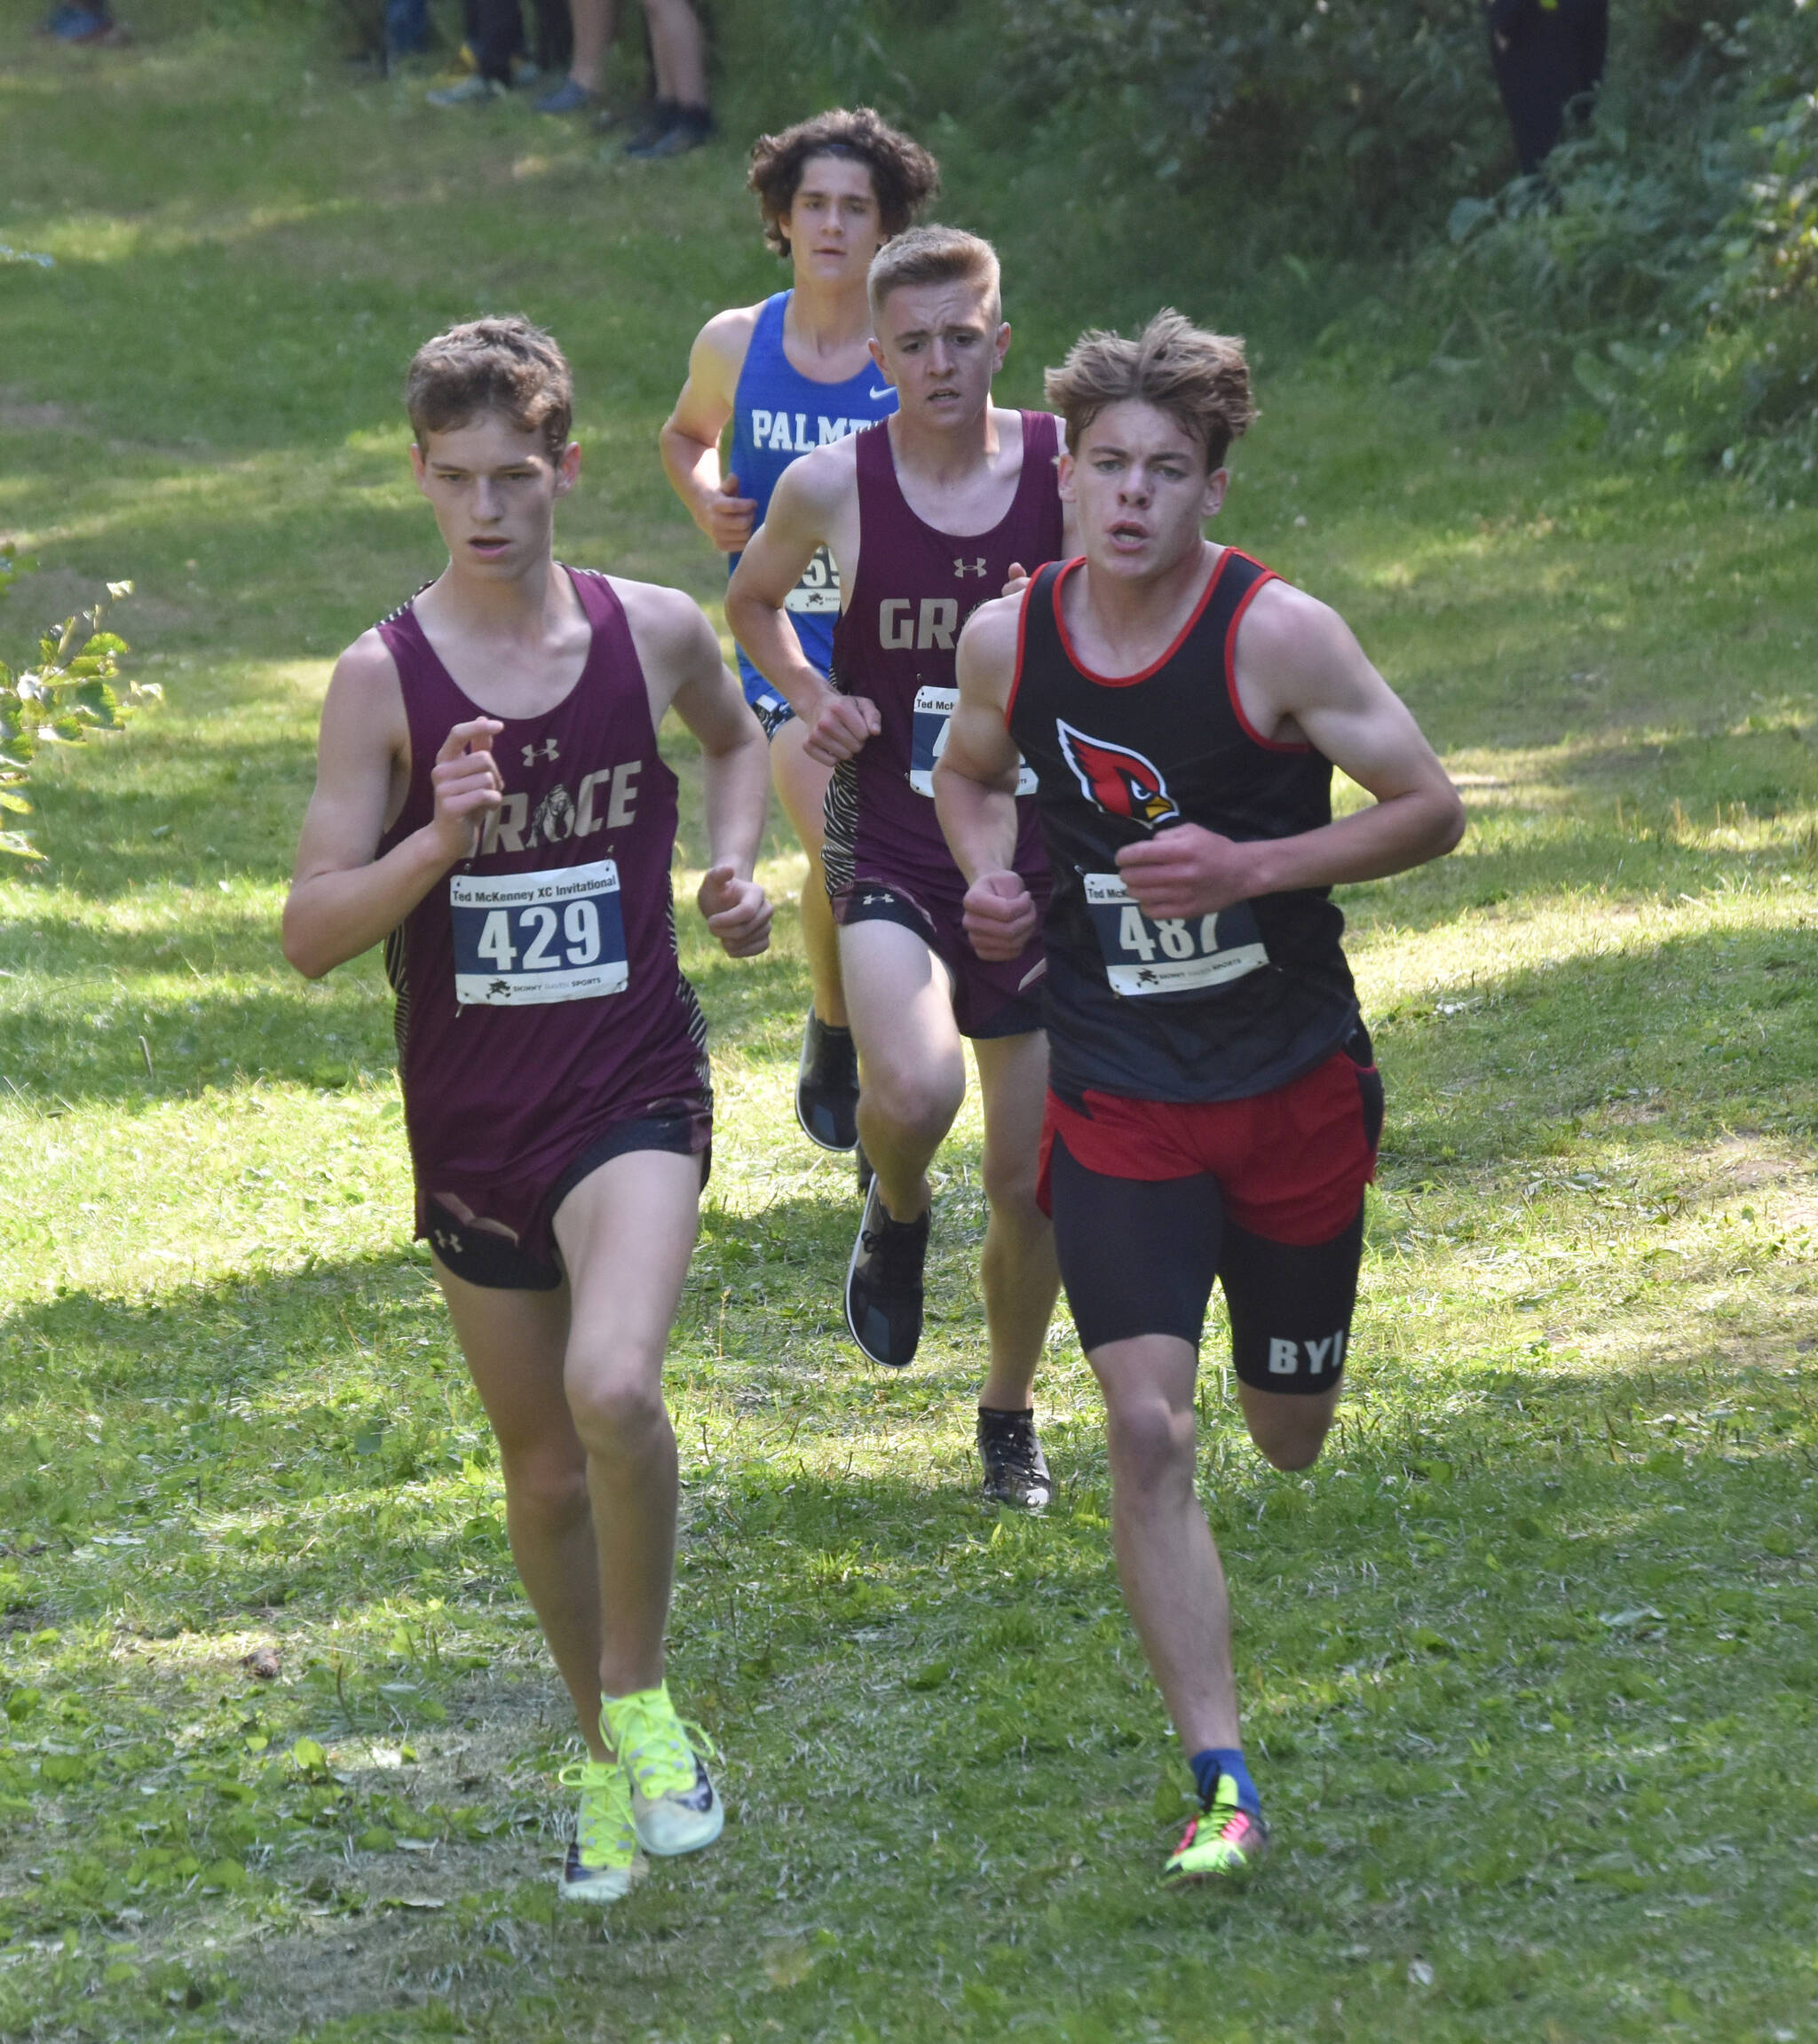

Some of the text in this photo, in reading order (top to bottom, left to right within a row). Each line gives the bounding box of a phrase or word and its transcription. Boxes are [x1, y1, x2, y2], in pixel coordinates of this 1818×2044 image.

[917, 699, 933, 709] Ted
[453, 875, 616, 902] Ted McKenney XC Invitational
[1087, 889, 1104, 899] Ted
[478, 899, 601, 971] 429
